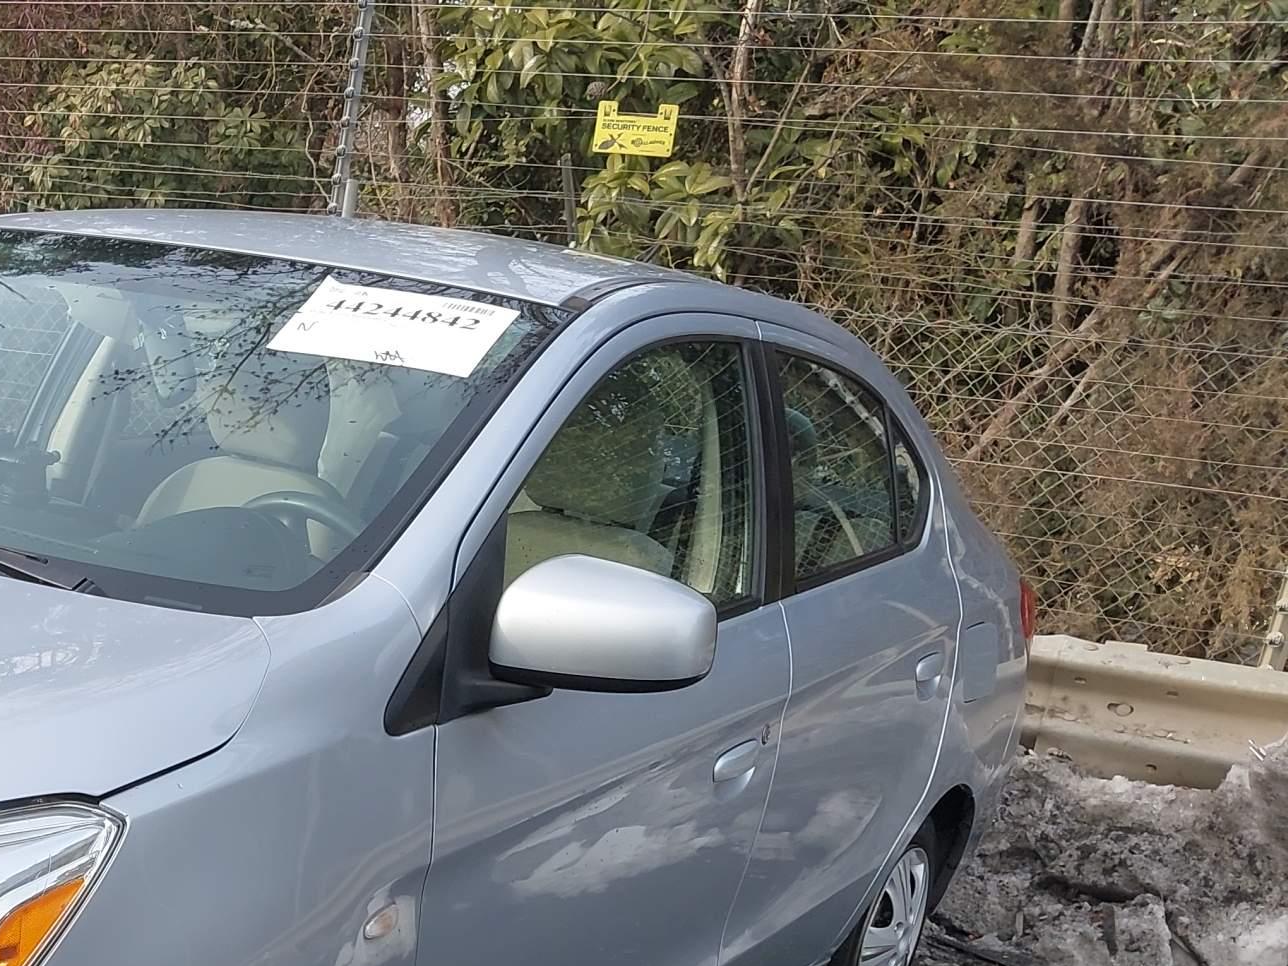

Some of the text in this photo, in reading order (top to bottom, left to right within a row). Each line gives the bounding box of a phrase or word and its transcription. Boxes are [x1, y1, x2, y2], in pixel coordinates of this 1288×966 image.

[601, 123, 669, 133] SECURITY FENCE
[325, 299, 481, 331] 44244842
